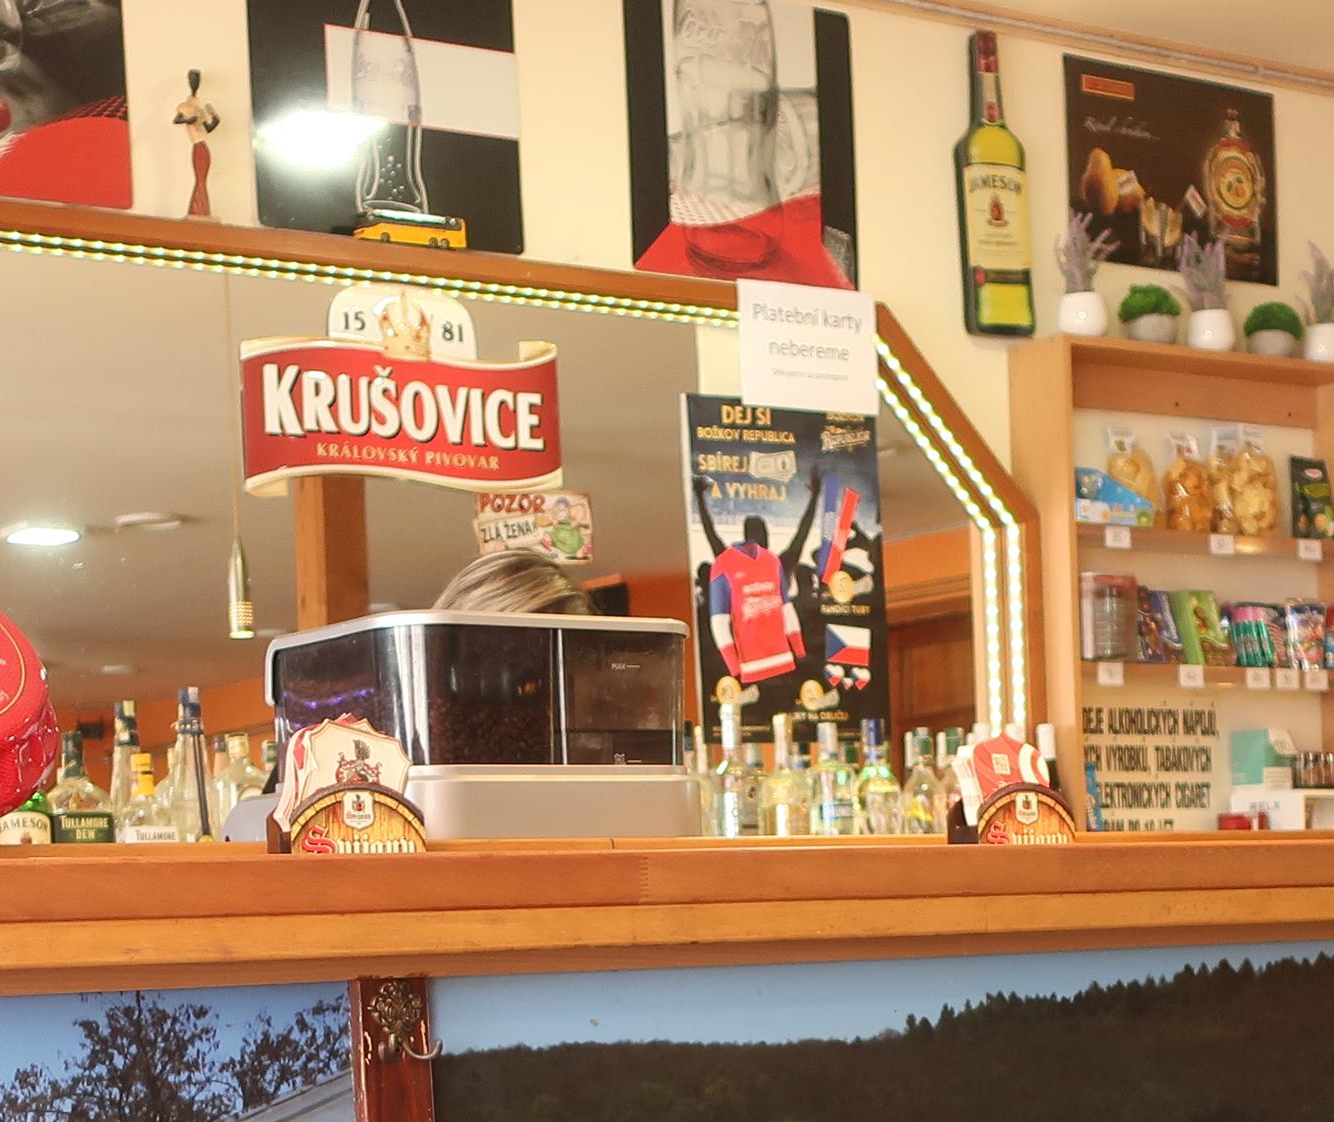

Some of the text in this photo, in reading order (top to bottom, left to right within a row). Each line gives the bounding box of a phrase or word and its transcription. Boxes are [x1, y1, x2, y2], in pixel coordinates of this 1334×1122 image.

[342, 311, 464, 342] 15 81
[752, 302, 863, 334] Platební karty
[768, 338, 850, 362] nebereme
[262, 363, 546, 452] KRUŠOVICE
[721, 405, 772, 426] DEJ SI
[697, 425, 796, 444] BOŽKOV REPUBLICA
[316, 441, 500, 470] KRÁLOVSKÝ PIVOVAR
[698, 451, 748, 473] SBÍREJ
[711, 482, 787, 502] A VYHRAJ
[479, 493, 545, 514] POZOR
[59, 815, 110, 830] TULLAMORE
[134, 828, 177, 842] TULLAMORE
